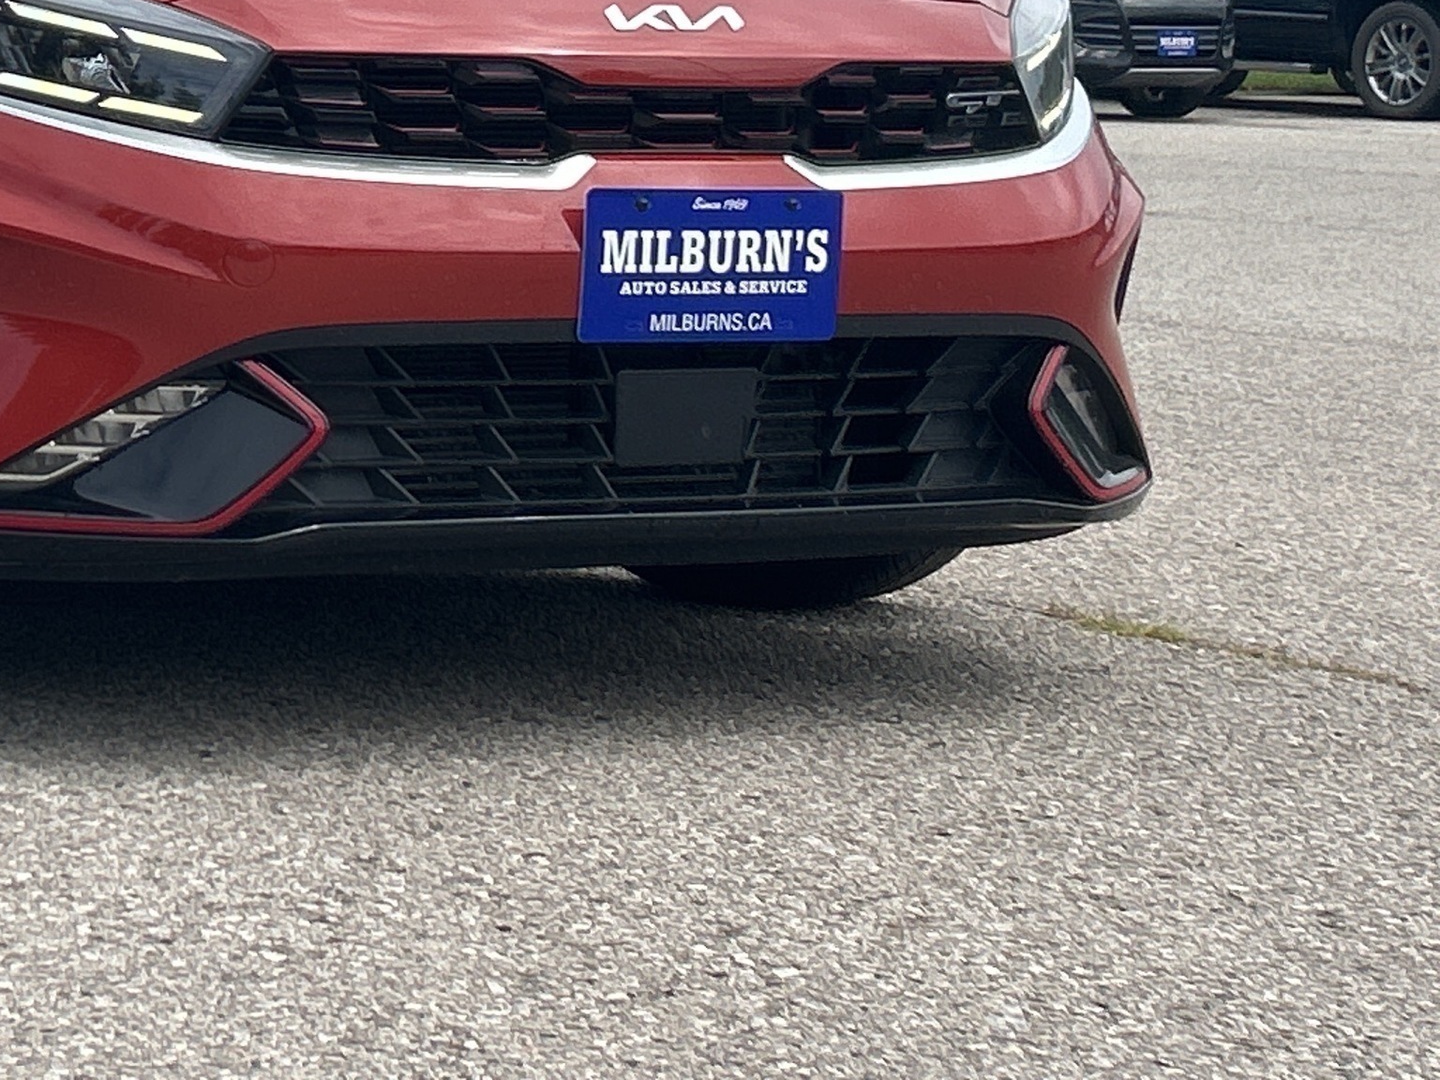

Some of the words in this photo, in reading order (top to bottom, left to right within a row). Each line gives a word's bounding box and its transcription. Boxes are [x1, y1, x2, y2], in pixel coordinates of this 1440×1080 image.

[603, 3, 746, 32] KIA
[600, 228, 829, 274] MILBURN'S
[619, 281, 667, 295] AUTO
[669, 281, 722, 295] SALES
[723, 281, 737, 295] &
[738, 279, 808, 295] SERVICE
[649, 312, 773, 332] MILBURNS.CA
